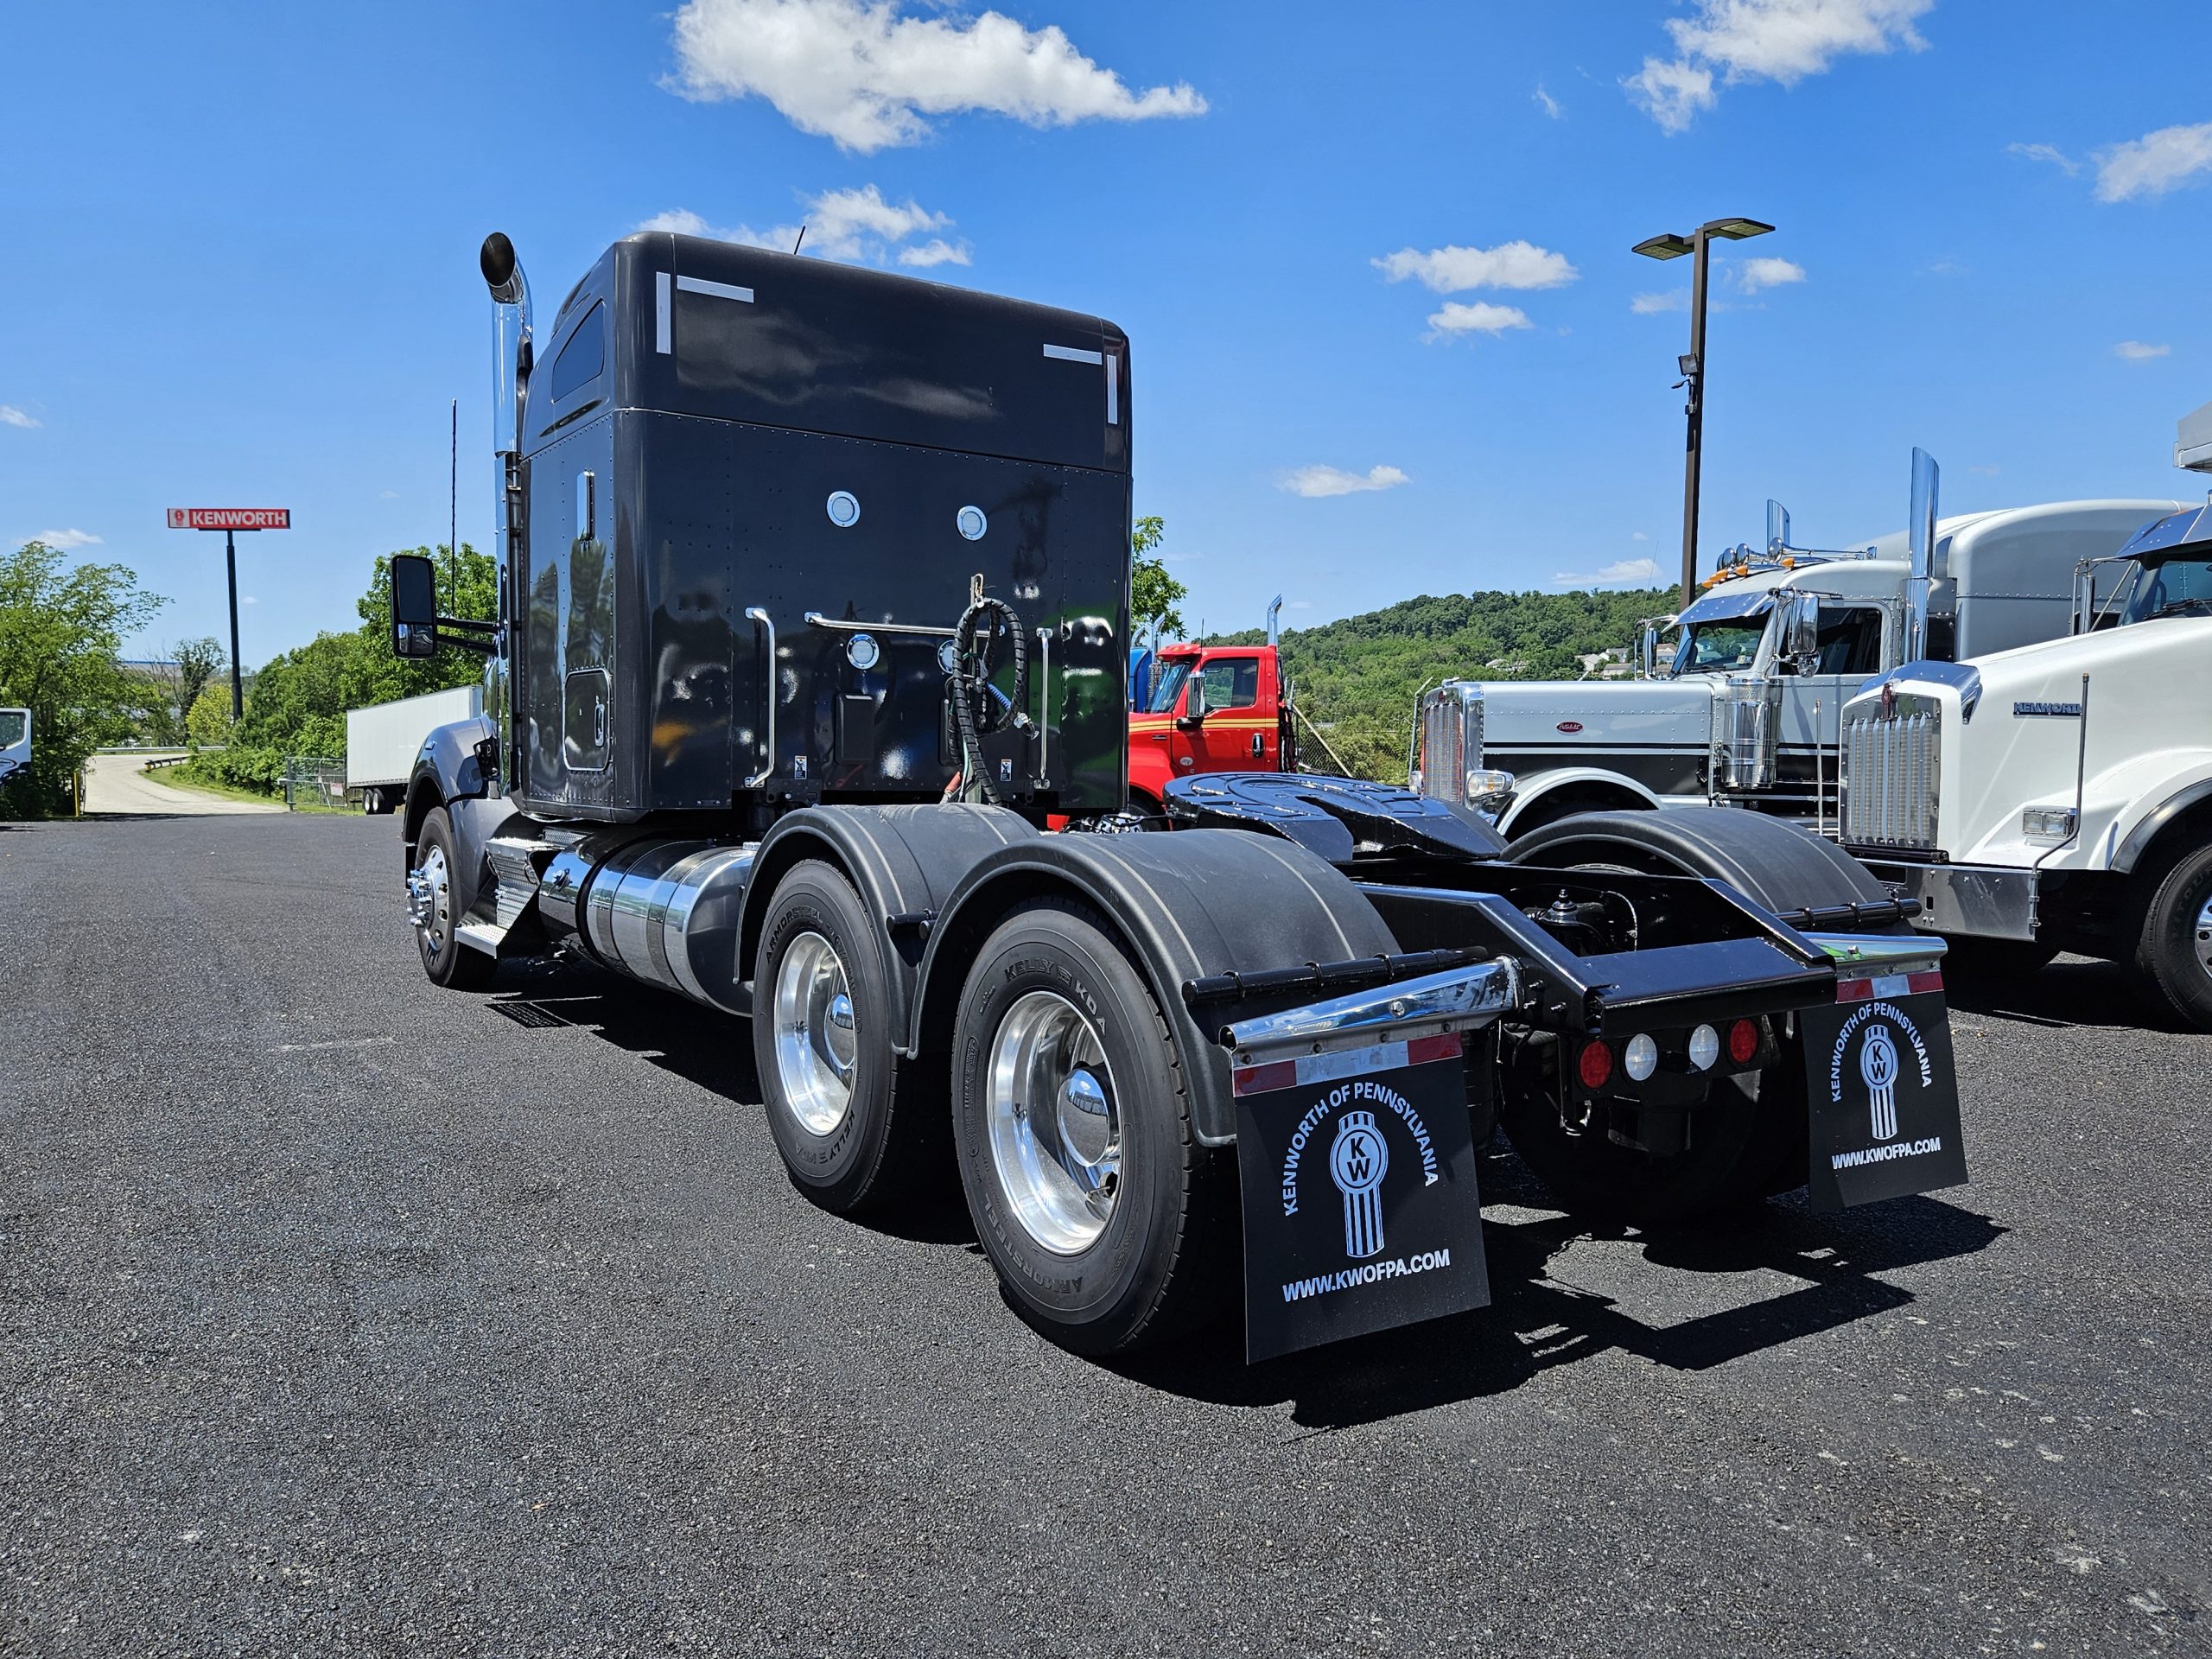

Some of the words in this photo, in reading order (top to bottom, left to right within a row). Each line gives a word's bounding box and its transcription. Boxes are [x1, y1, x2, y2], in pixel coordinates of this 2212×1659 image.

[193, 511, 287, 526] KENWORTH
[766, 905, 823, 965] ARMORSTEEL
[1004, 957, 1055, 983] KELLY
[1074, 979, 1106, 1037] KDA
[1831, 1013, 1859, 1102] KENWORTH
[1859, 1004, 1872, 1020] OF
[1874, 1002, 1932, 1087] PENNSYLVANIA
[1872, 1045, 1884, 1063] K
[1872, 1063, 1886, 1080] W
[830, 1109, 855, 1161] KELLY
[1283, 1097, 1329, 1217] KENWORTH
[1329, 1084, 1351, 1109] OF
[1354, 1082, 1439, 1186] PENNSYLVANIA
[1351, 1136, 1365, 1159] K
[1832, 1137, 1941, 1169] WWW.KWOFPA.COM
[1347, 1158, 1370, 1181] W
[984, 1192, 1084, 1295] ARMORSTEEL
[1282, 1248, 1451, 1302] WWW.KWOFPA.COM
